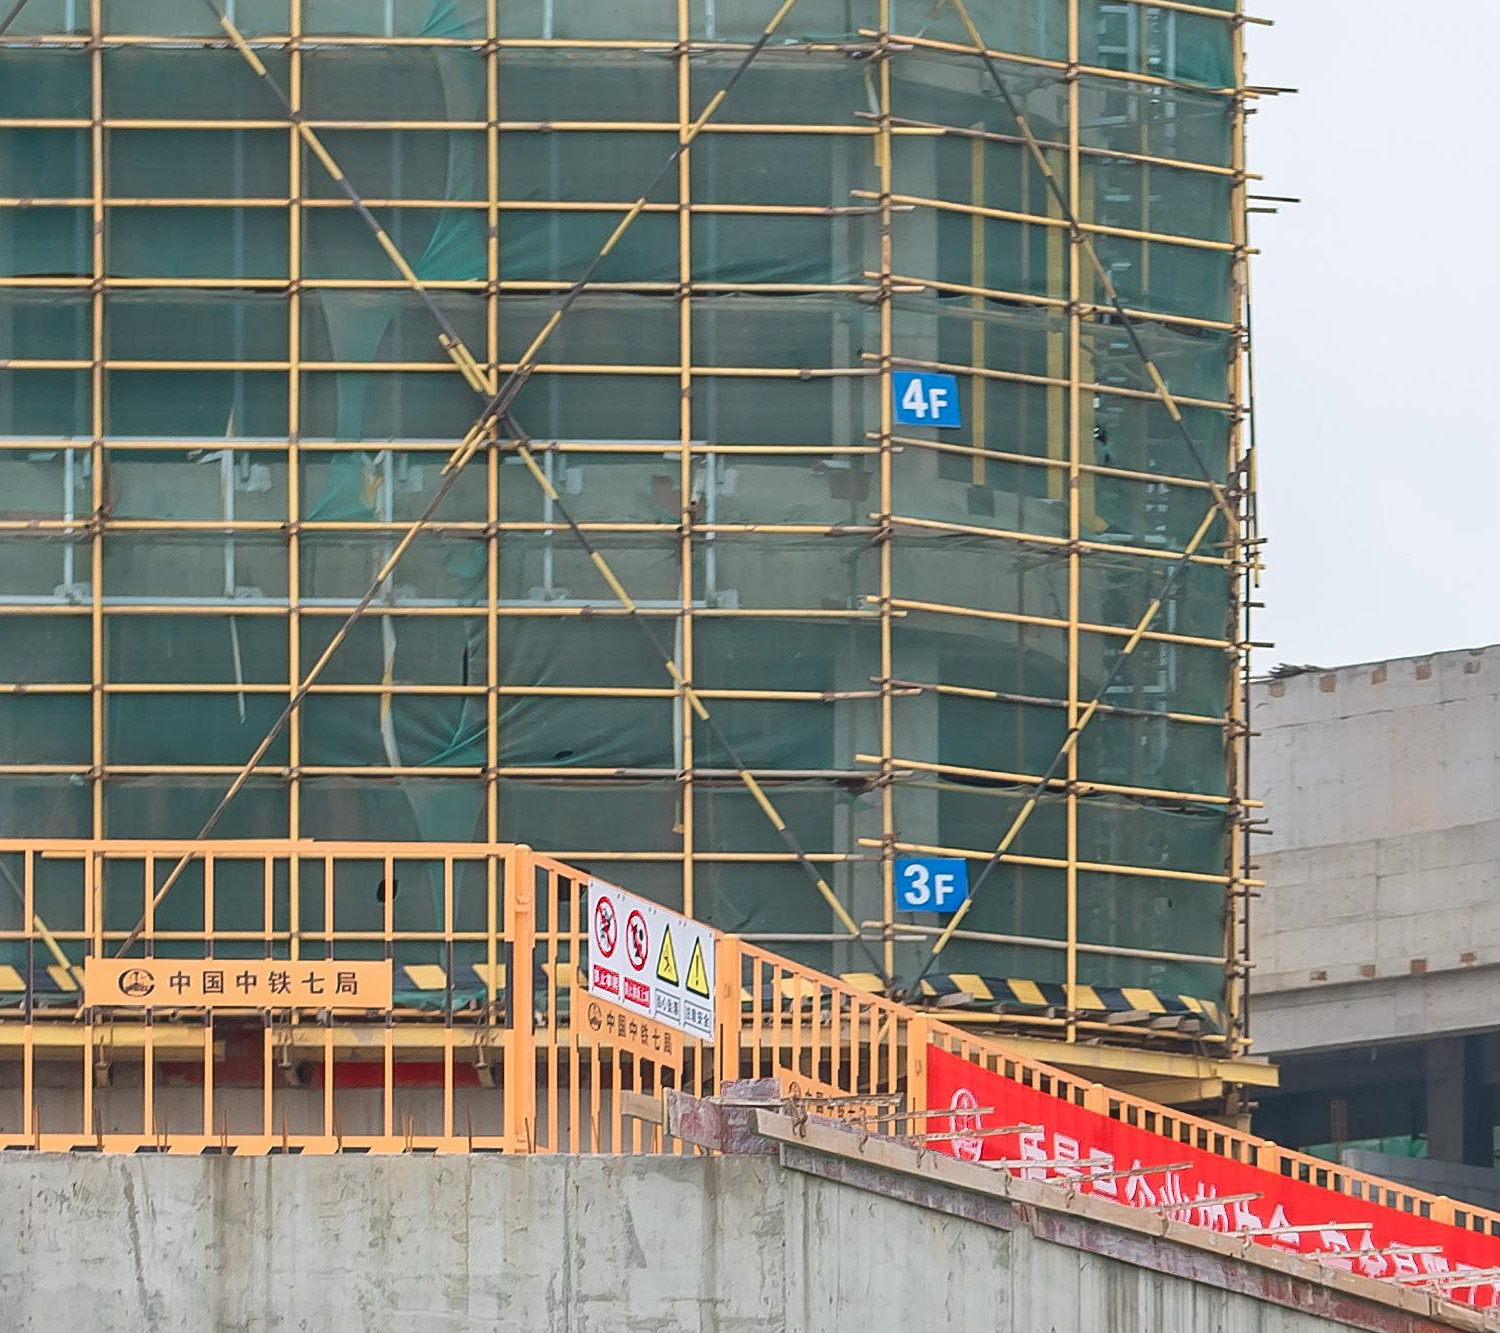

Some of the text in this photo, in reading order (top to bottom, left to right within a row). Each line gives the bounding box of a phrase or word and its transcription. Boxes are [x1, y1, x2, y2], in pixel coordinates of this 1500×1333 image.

[902, 378, 948, 419] 4F
[901, 863, 956, 909] 3F
[168, 970, 359, 996] 中国中铁七局
[606, 1010, 673, 1056] 中国中铁七局
